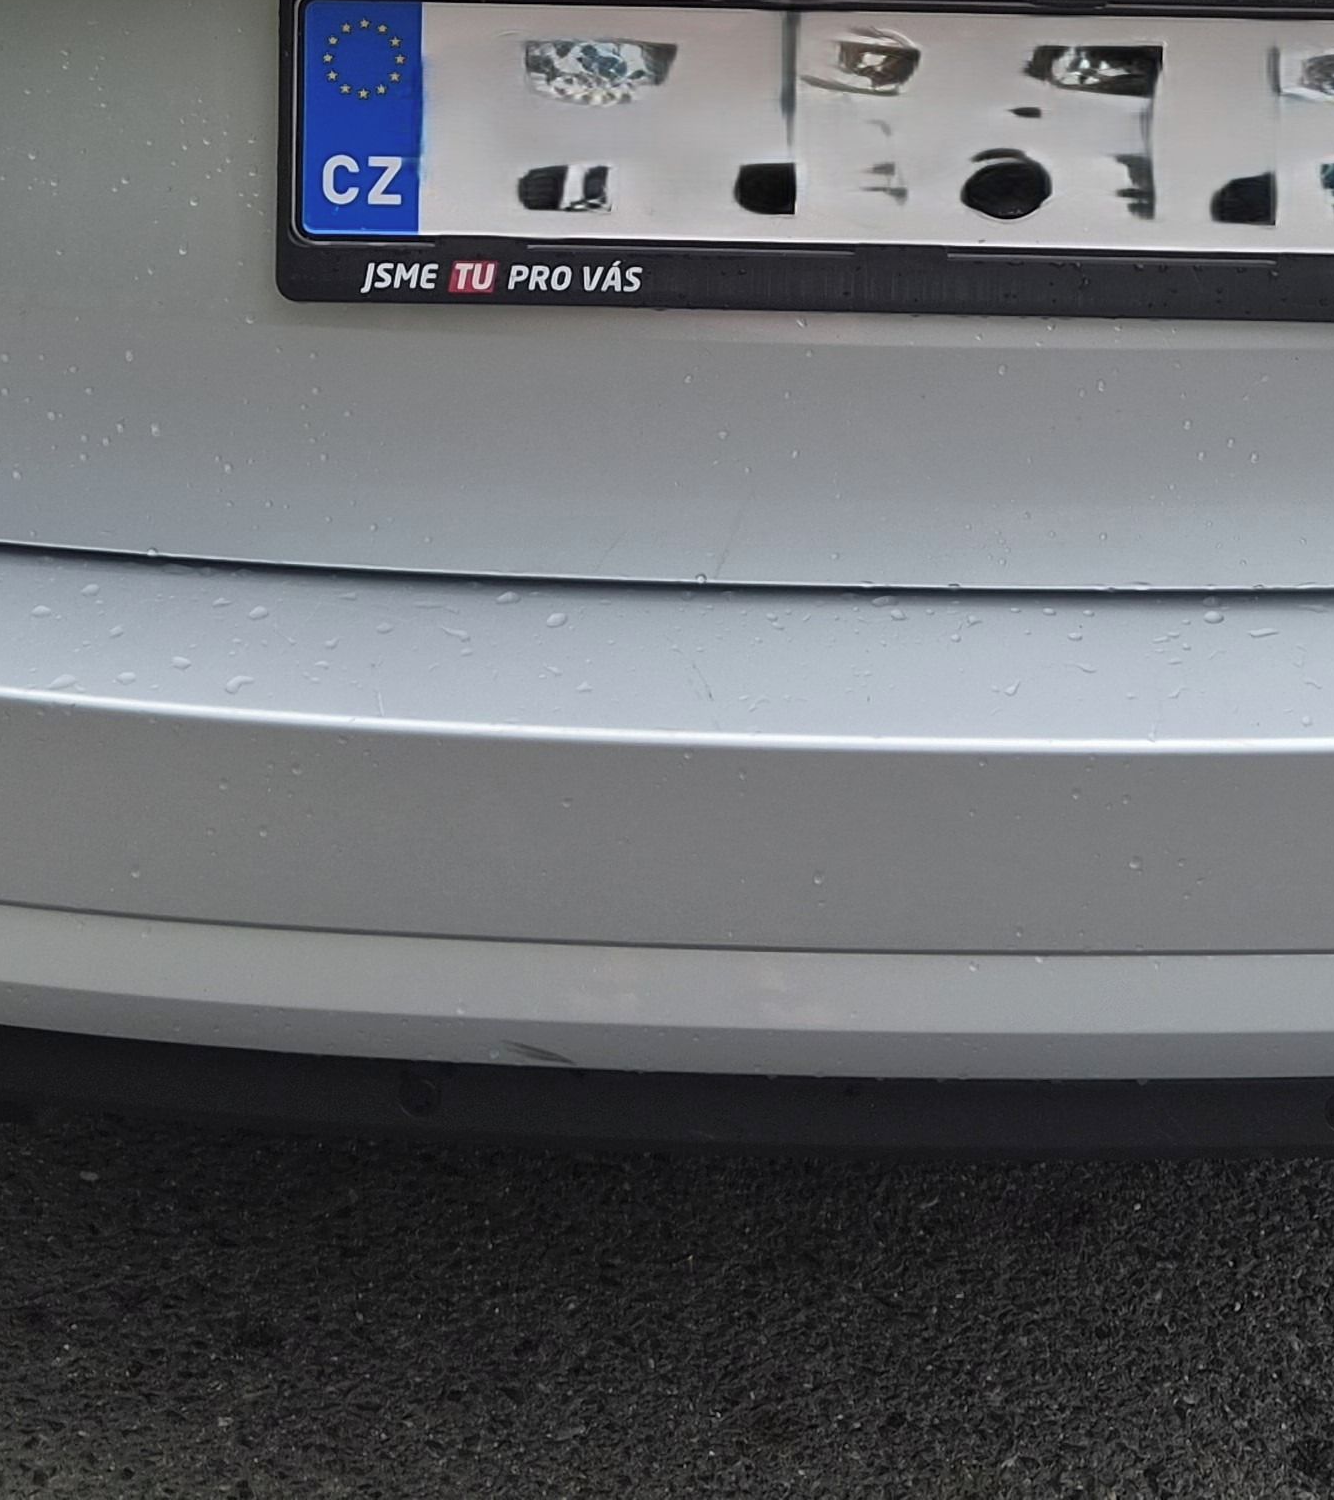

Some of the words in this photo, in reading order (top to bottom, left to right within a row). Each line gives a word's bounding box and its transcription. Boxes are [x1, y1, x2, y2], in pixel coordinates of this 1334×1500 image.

[322, 154, 403, 206] CZ
[360, 262, 439, 293] JSME
[454, 262, 496, 290] TU
[507, 265, 572, 291] PRO
[582, 260, 644, 292] VÁS
